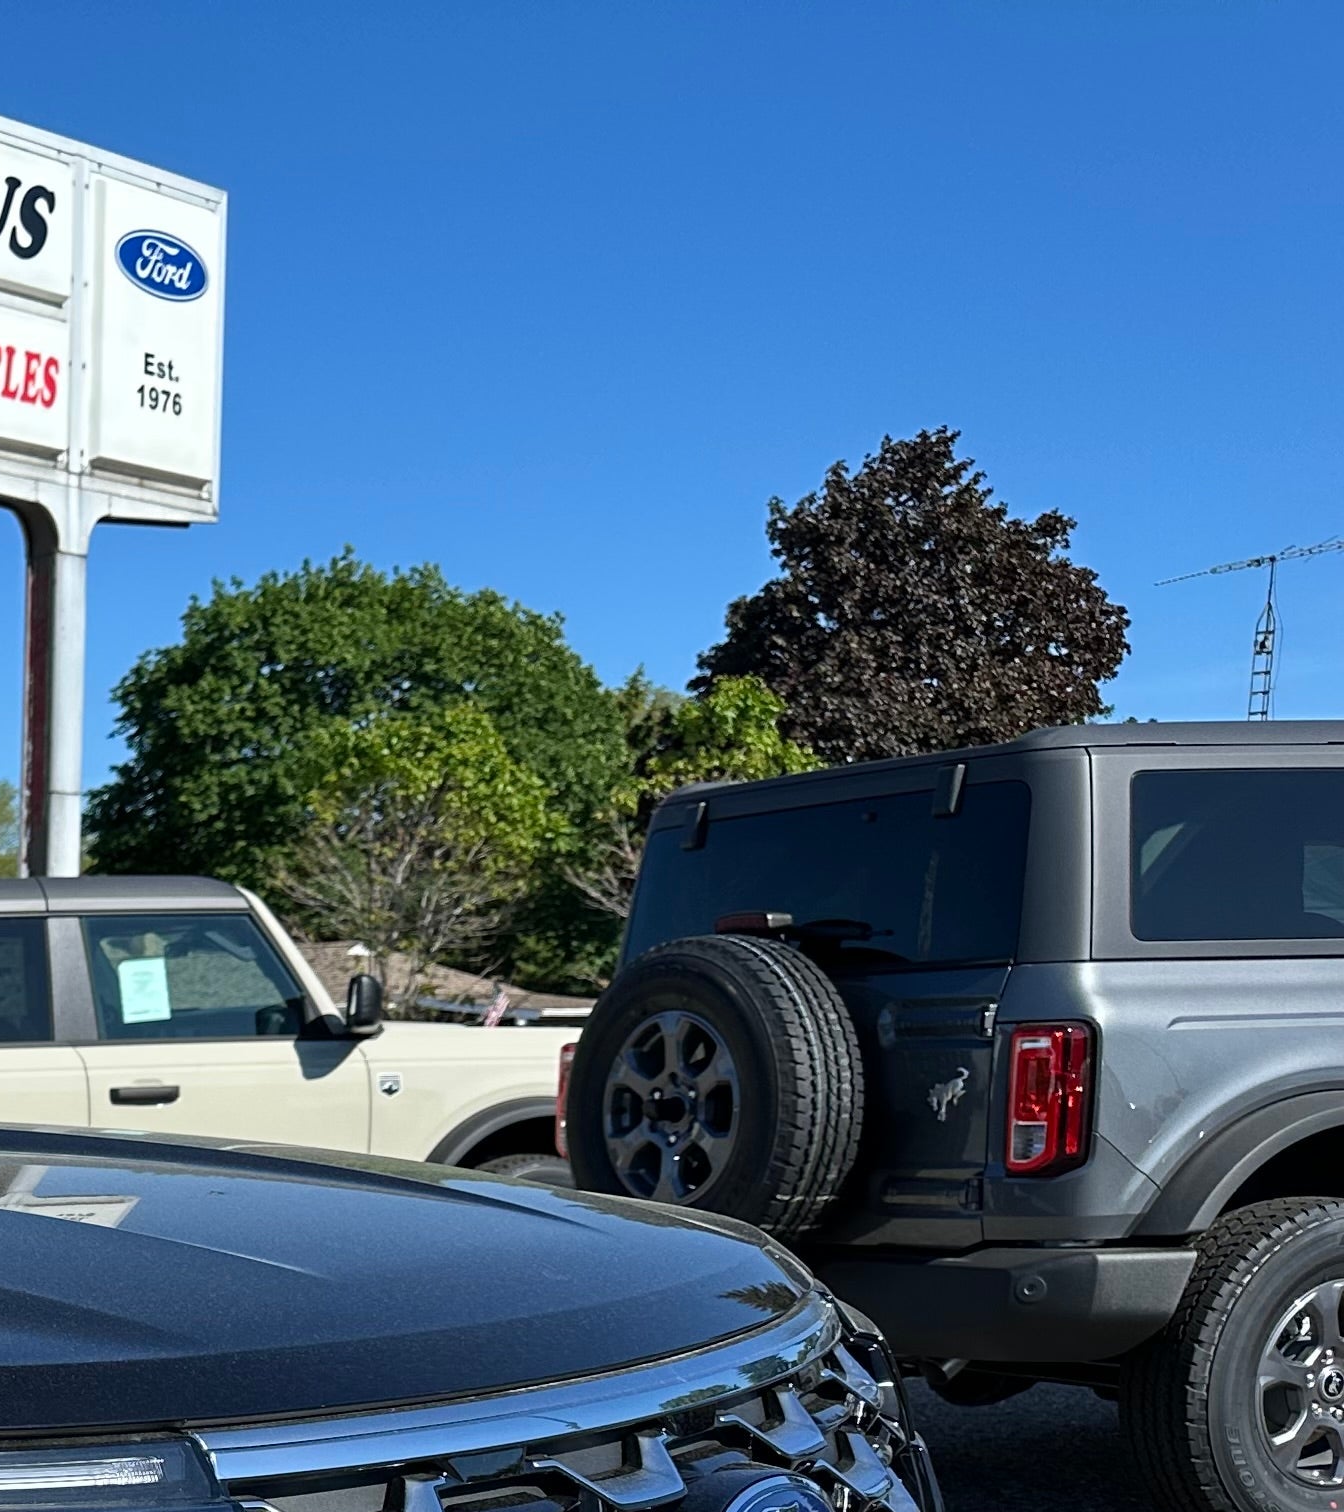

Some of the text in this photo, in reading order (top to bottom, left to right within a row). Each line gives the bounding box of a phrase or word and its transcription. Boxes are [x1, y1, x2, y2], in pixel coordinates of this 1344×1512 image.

[135, 237, 192, 290] Ford
[143, 352, 179, 382] Est.
[136, 384, 182, 416] 1976
